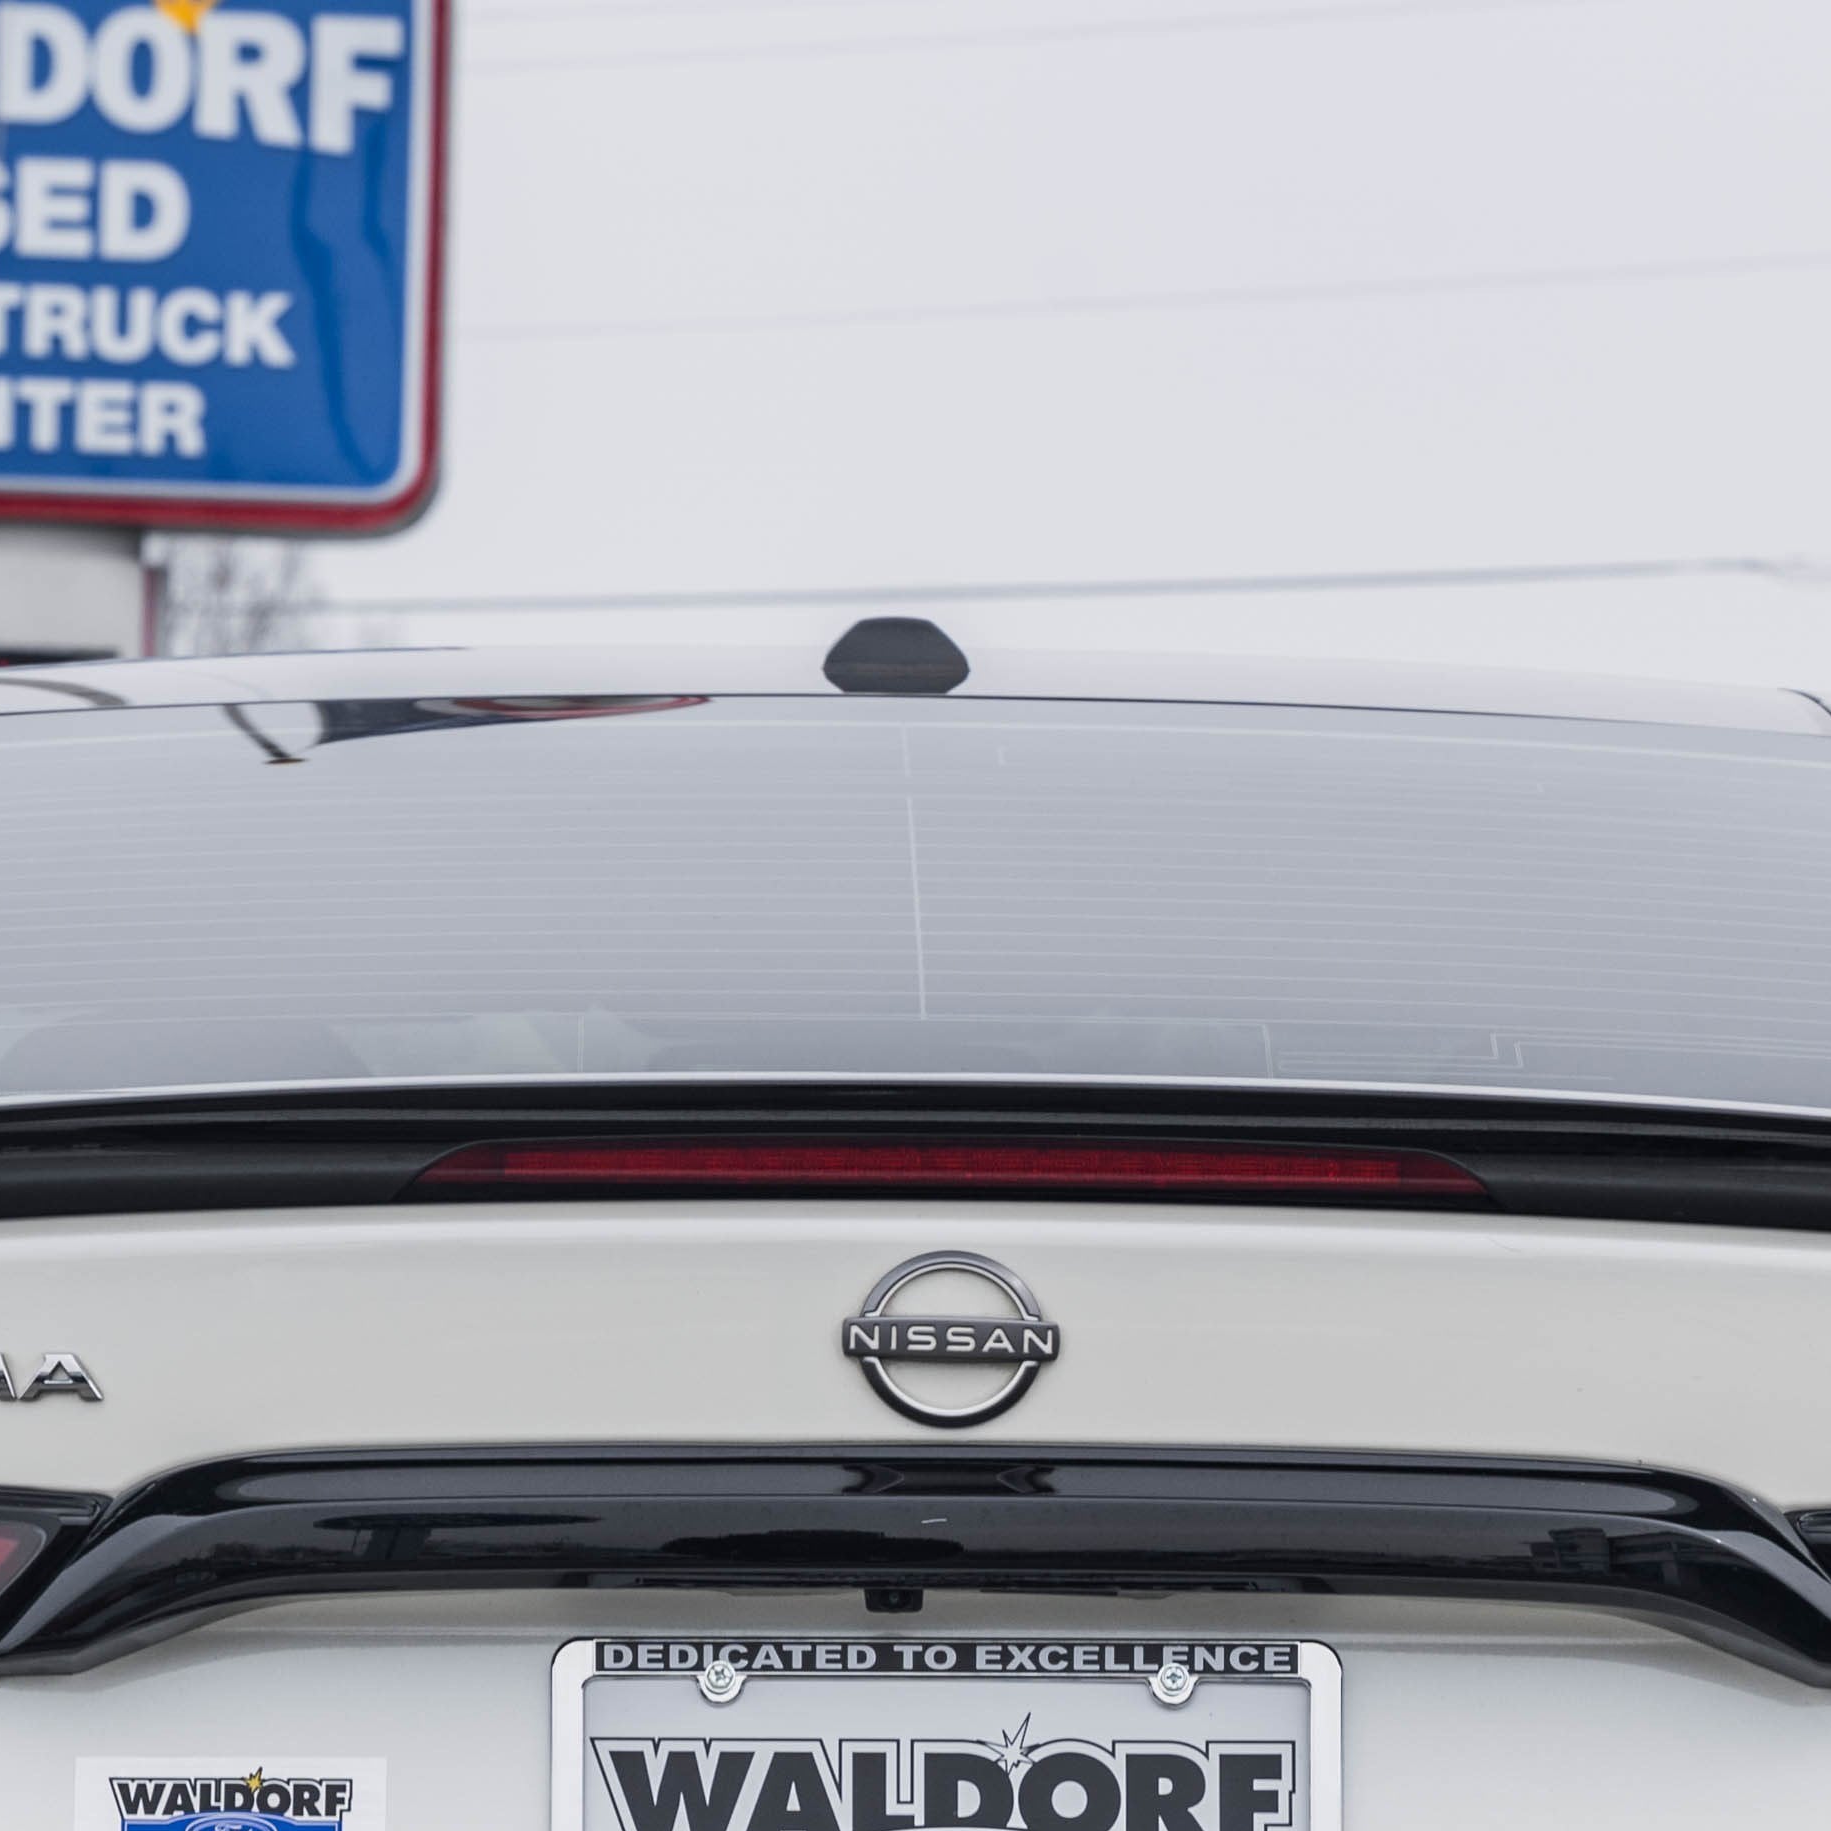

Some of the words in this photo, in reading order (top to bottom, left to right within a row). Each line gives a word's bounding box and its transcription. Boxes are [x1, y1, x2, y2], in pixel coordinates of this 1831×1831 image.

[848, 1324, 1054, 1355] NISSAN
[603, 1643, 878, 1671] DEDICATED
[893, 1644, 957, 1671] TO
[975, 1645, 1291, 1672] EXCELLENCE
[114, 1780, 350, 1817] WALDORF
